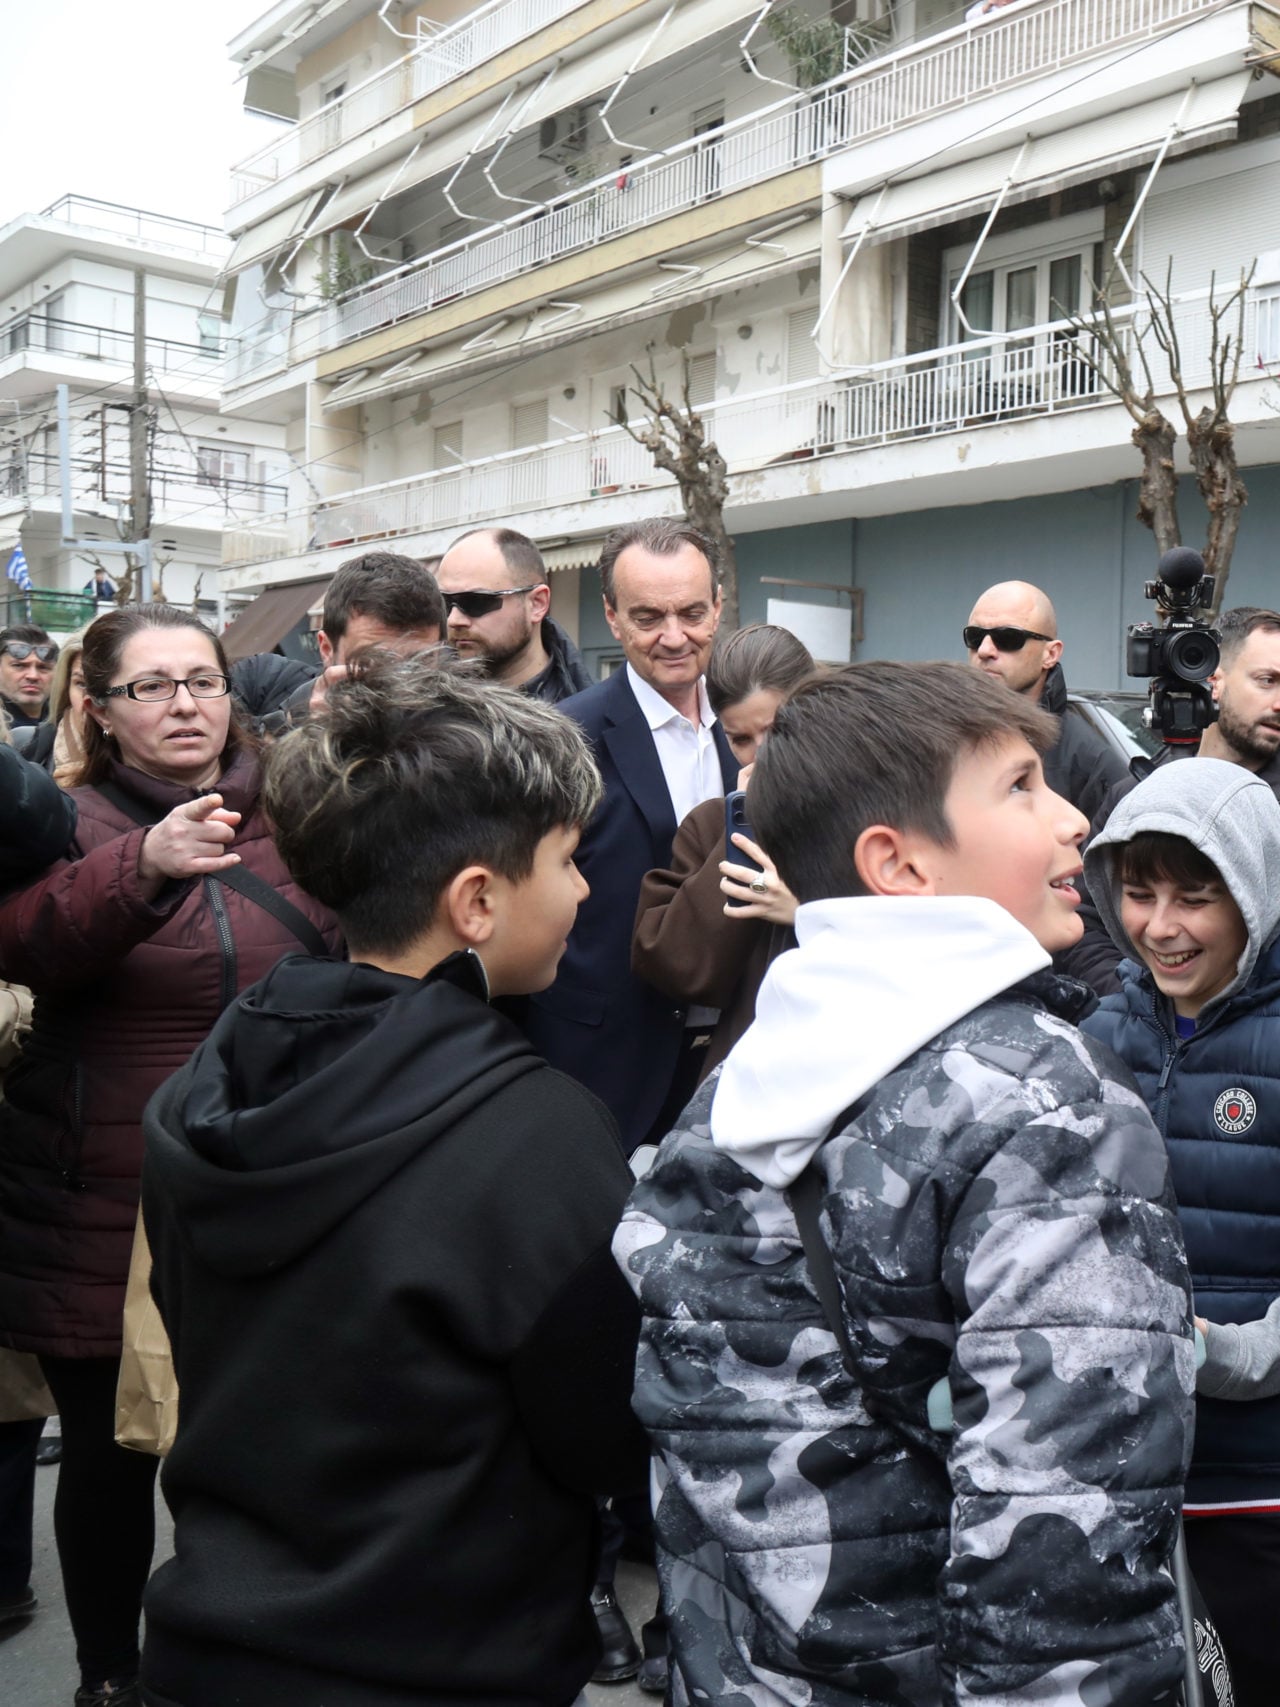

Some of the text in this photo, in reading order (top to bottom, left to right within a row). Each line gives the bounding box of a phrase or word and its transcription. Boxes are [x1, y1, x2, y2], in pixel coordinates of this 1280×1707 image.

[1216, 1091, 1253, 1114] CHICAGO COLLEGE
[1220, 1121, 1246, 1131] LEAGUE
